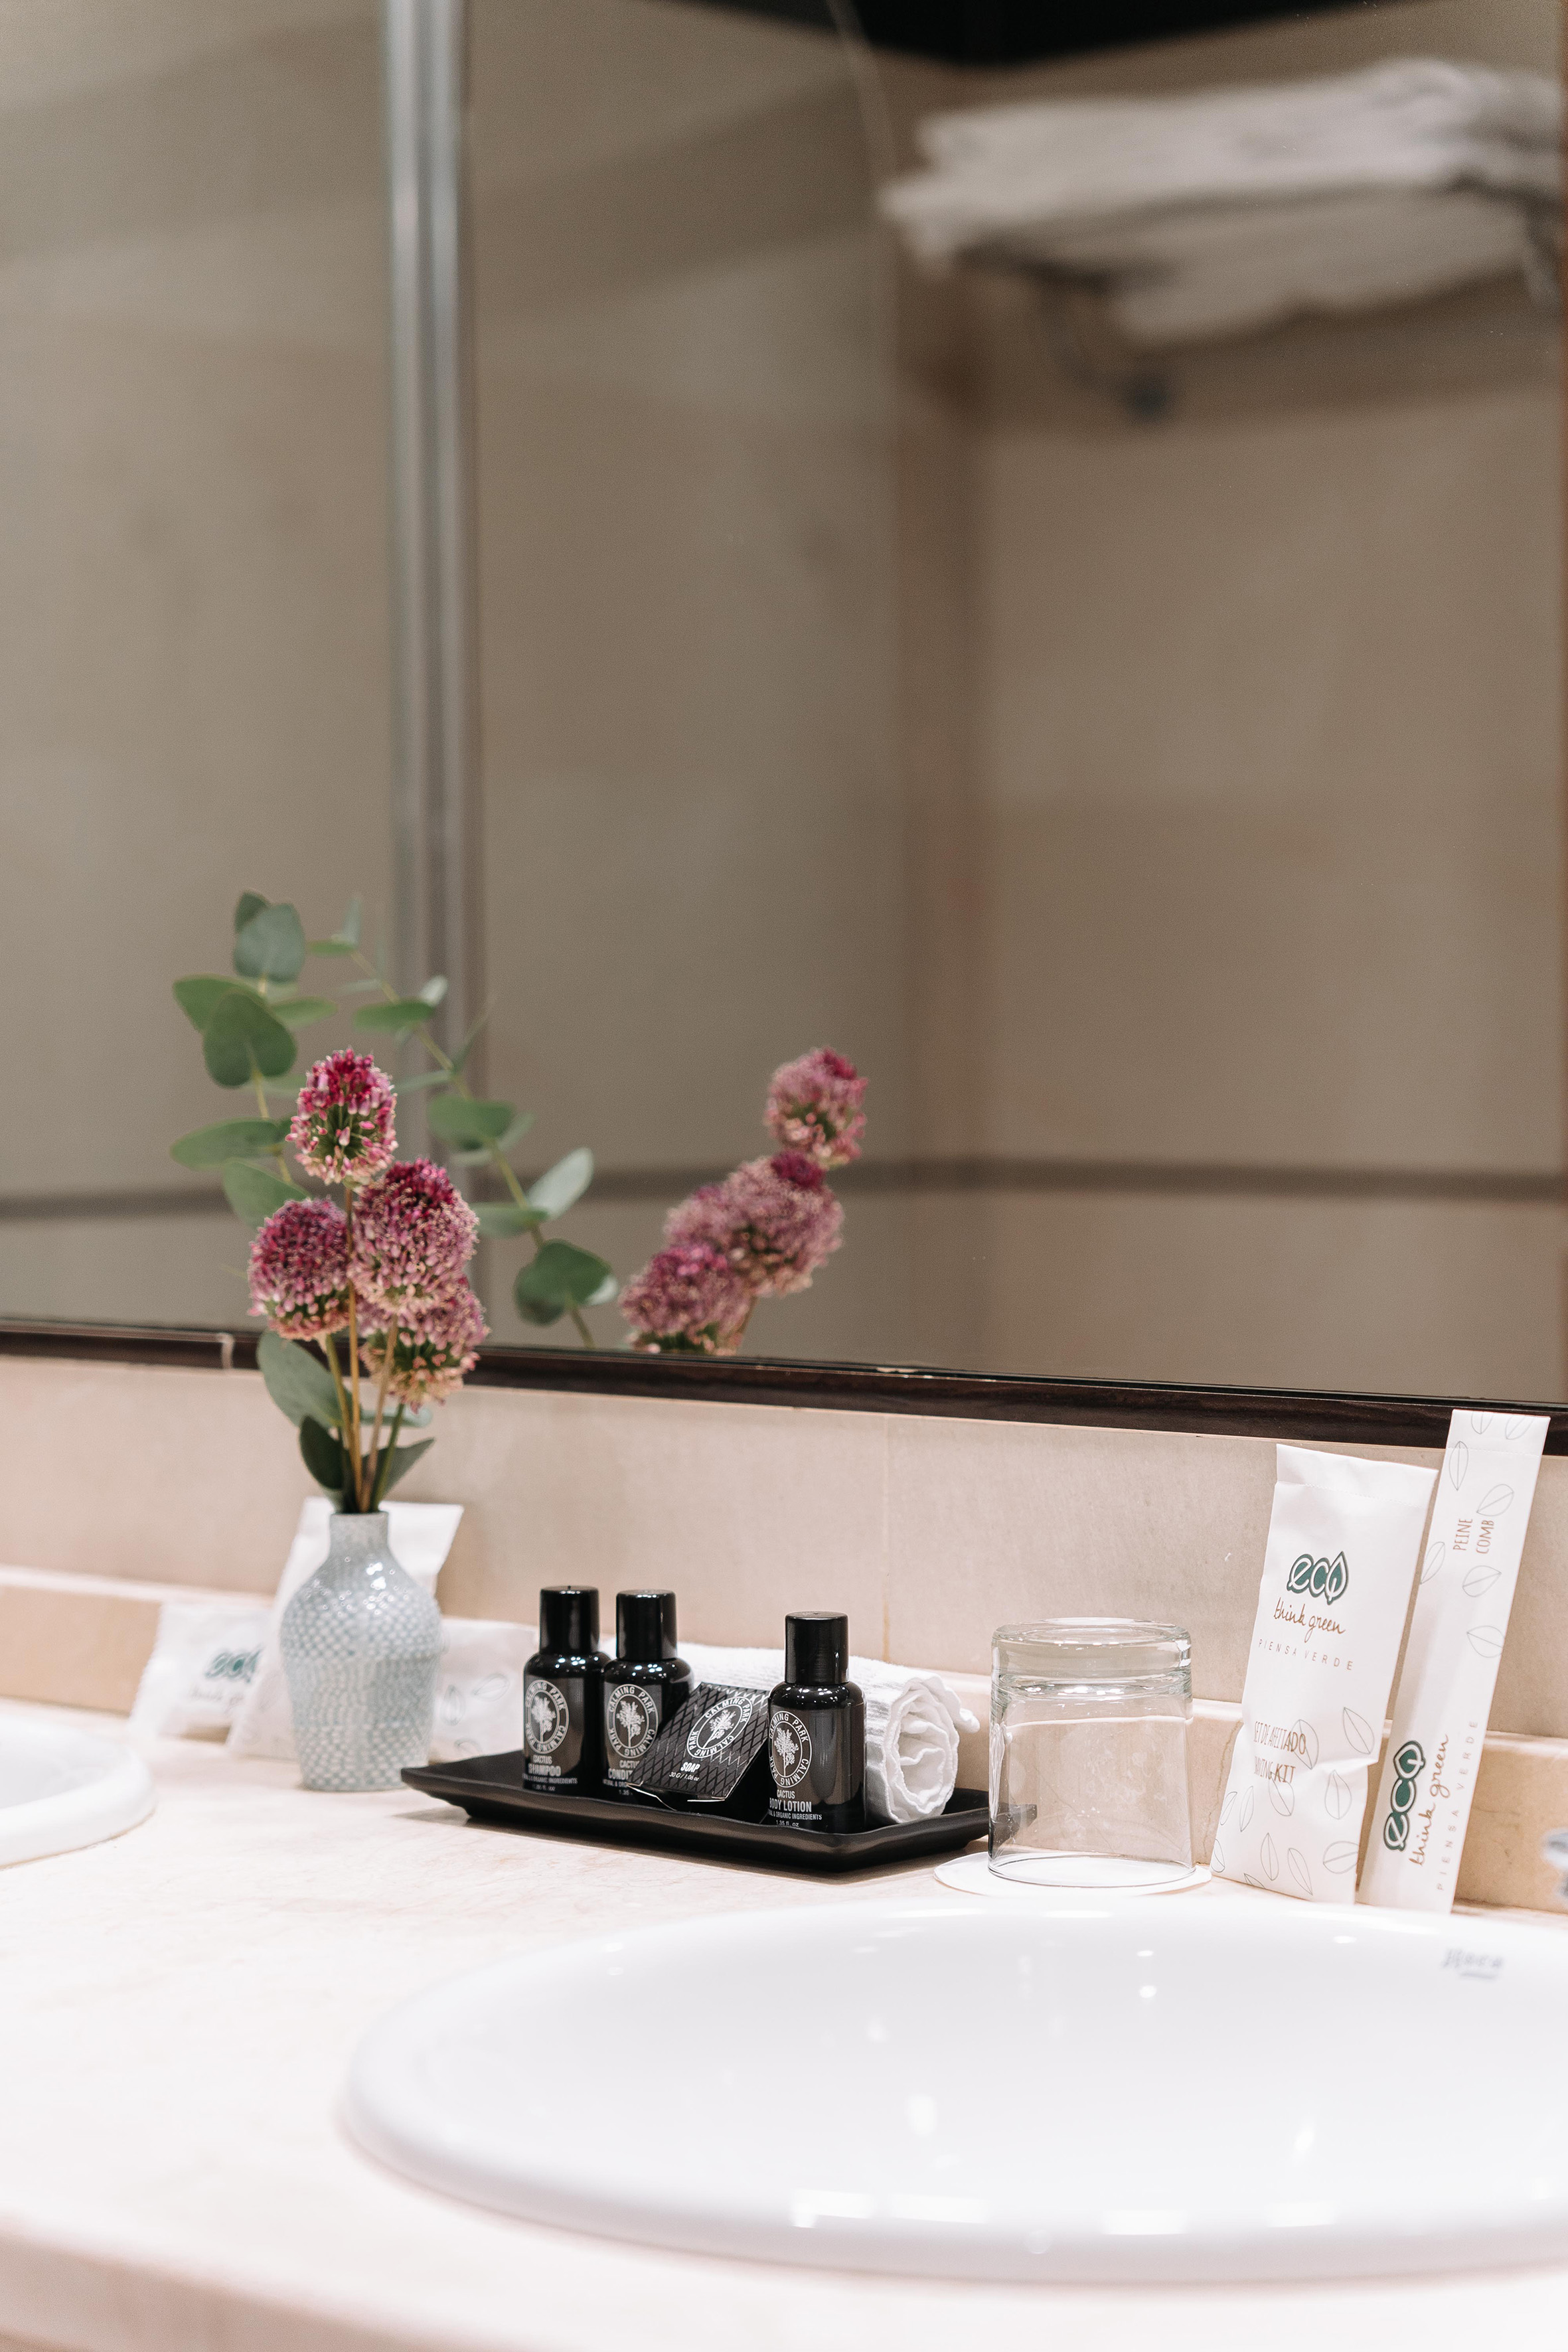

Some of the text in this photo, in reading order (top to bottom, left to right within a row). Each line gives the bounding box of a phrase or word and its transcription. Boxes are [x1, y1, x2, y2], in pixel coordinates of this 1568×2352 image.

[1452, 1518, 1473, 1551] PEINE
[1476, 1520, 1494, 1554] COMB
[1287, 1551, 1349, 1606] eco
[1273, 1597, 1346, 1643] think green
[1259, 1638, 1353, 1671] PIENSA VERDE
[638, 1691, 655, 1714] PARK
[704, 1698, 750, 1723] CALMING PARK
[769, 1713, 809, 1743] CALMING PARK
[624, 1729, 655, 1756] CALMING
[688, 1731, 734, 1757] CALMING PARK
[528, 1763, 561, 1776] SHAMPOO
[533, 1755, 552, 1764] CACTUS
[619, 1760, 639, 1768] CACTU
[680, 1762, 700, 1772] SOAP
[781, 1759, 809, 1786] CALMING
[1275, 1763, 1296, 1784] KIT
[769, 1798, 782, 1810] BODY
[783, 1800, 812, 1812] LOTION
[777, 1789, 795, 1799] CACTUS
[1383, 1740, 1426, 1851] eco
[1409, 1734, 1450, 1865] think green
[1437, 1721, 1478, 1890] PIENSA VERDE
